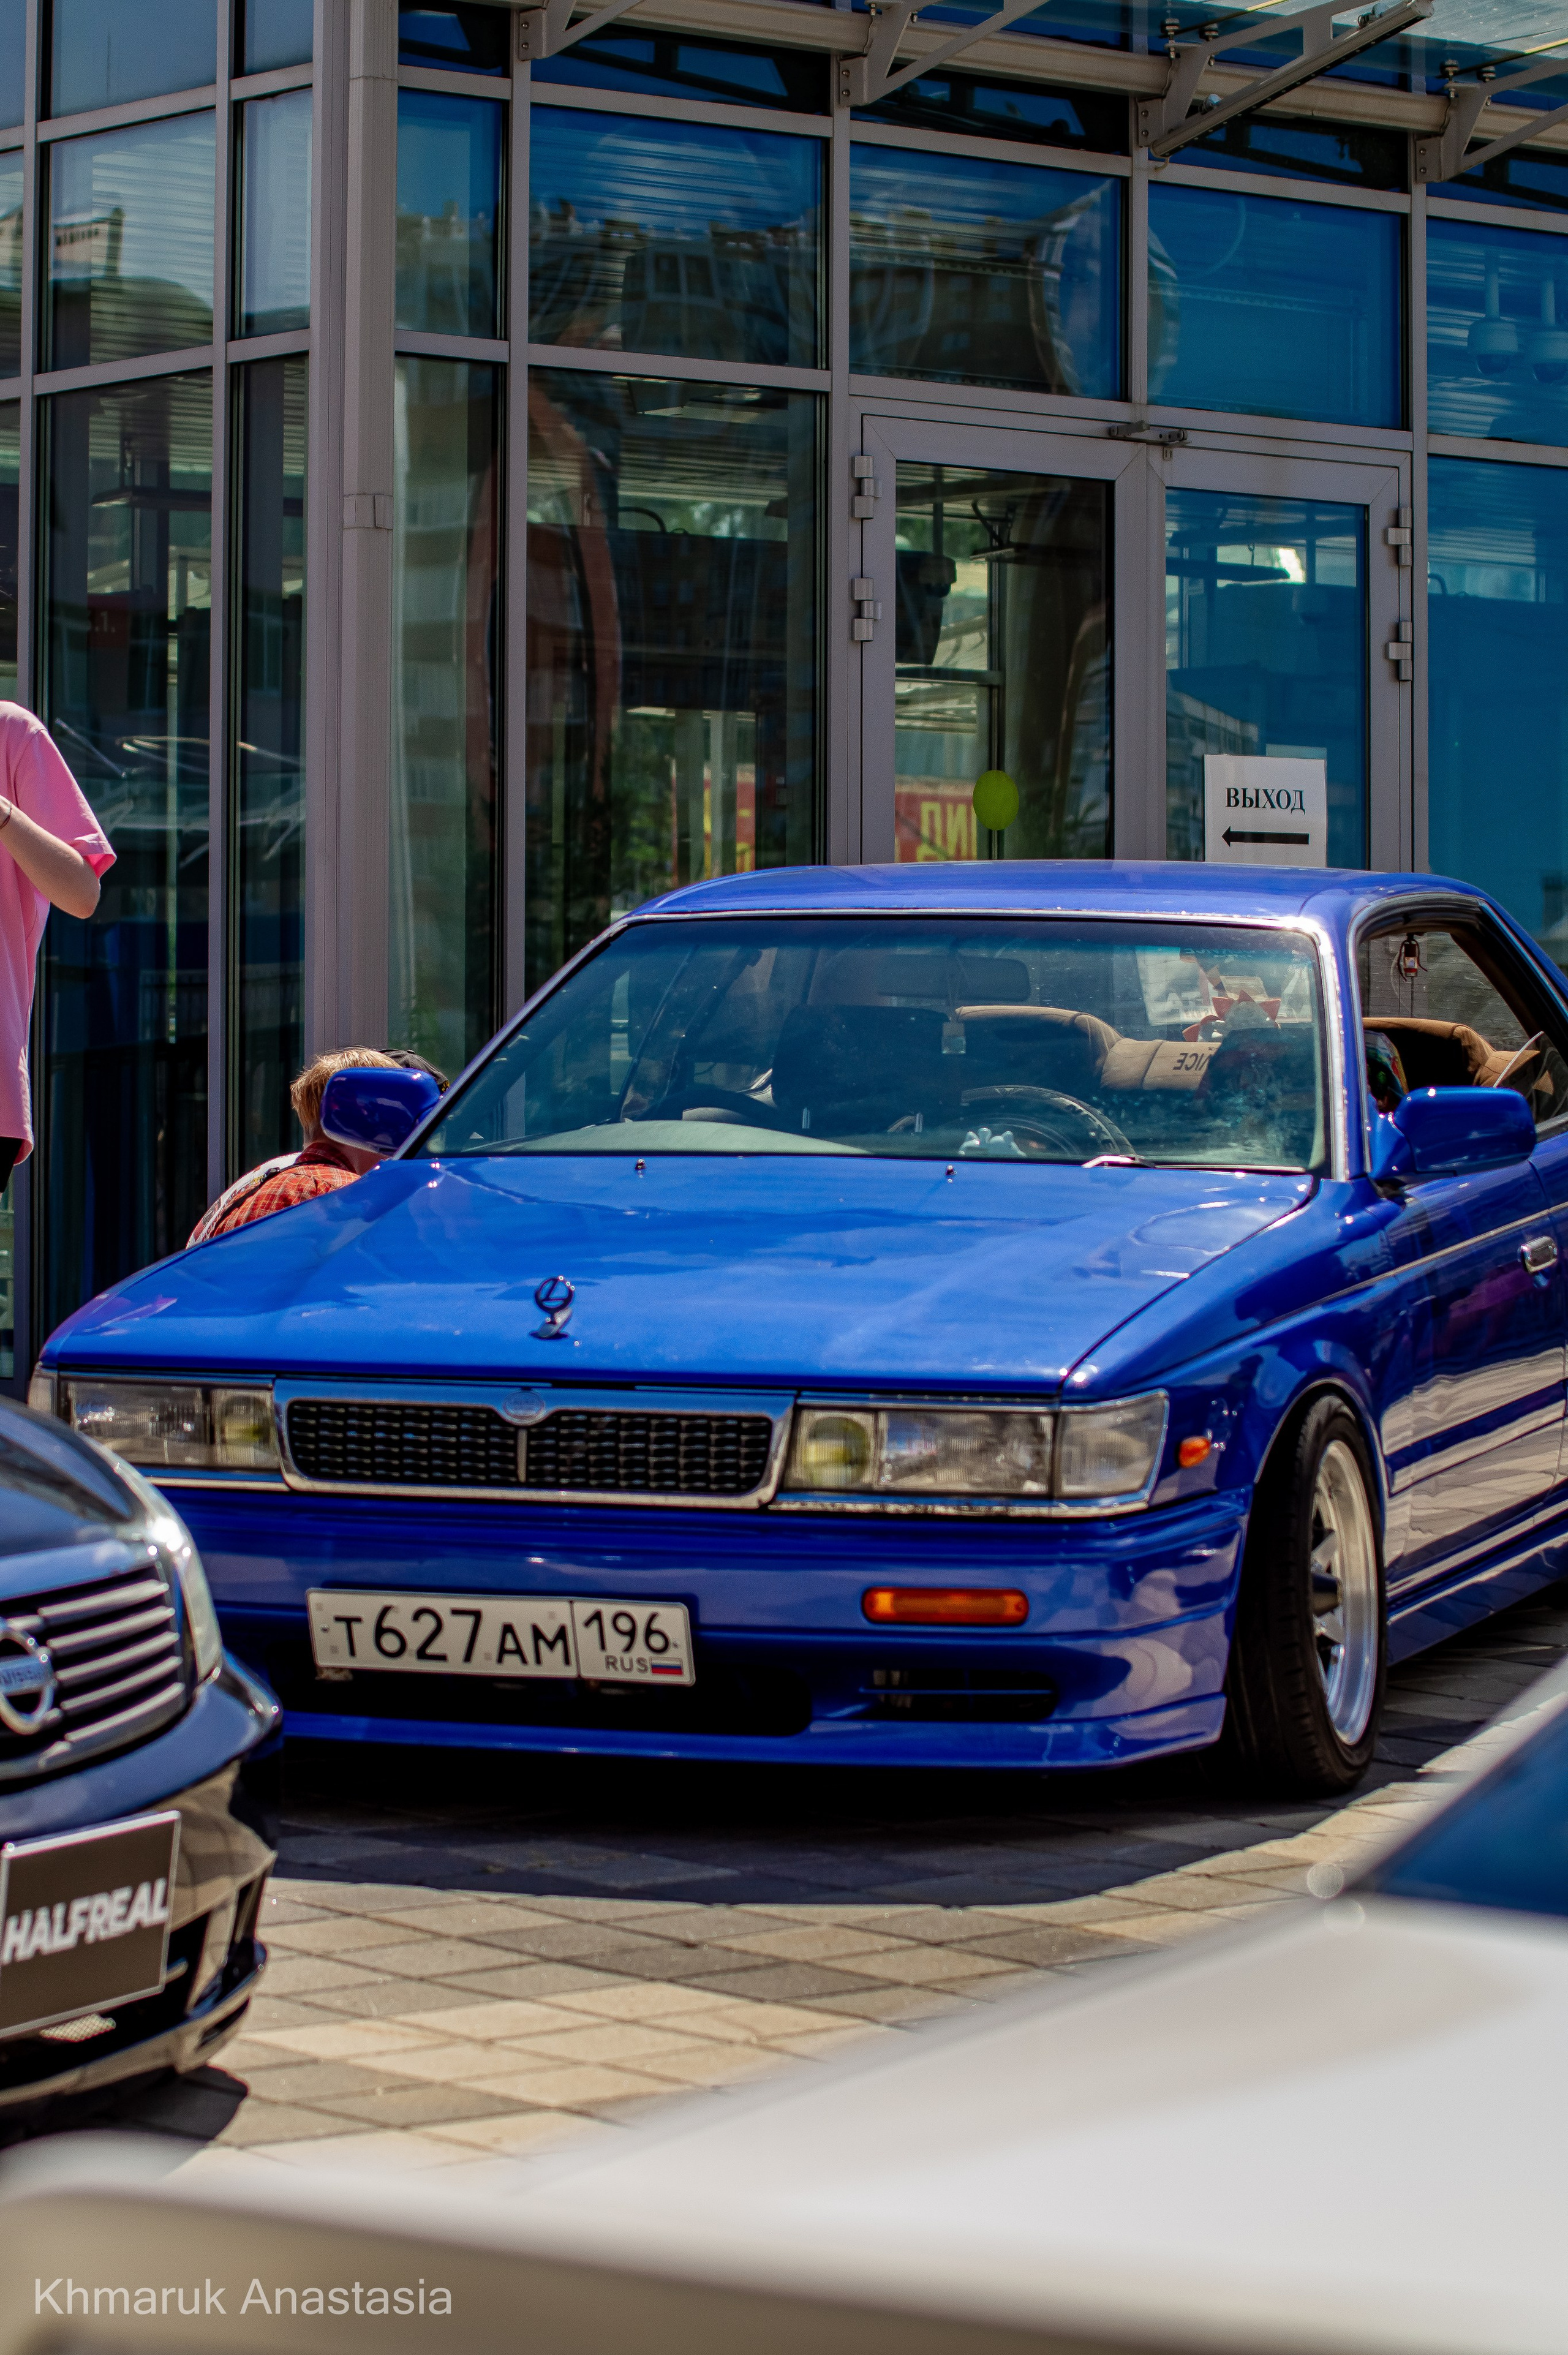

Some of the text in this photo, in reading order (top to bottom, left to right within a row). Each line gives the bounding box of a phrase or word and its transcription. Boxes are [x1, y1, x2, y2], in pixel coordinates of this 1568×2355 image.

[1225, 787, 1306, 815] ВЫХОД
[334, 1604, 572, 1666] Т627АМ
[583, 1608, 671, 1654] 196
[605, 1654, 649, 1673] RUS
[1, 1877, 170, 1966] HALFREAL
